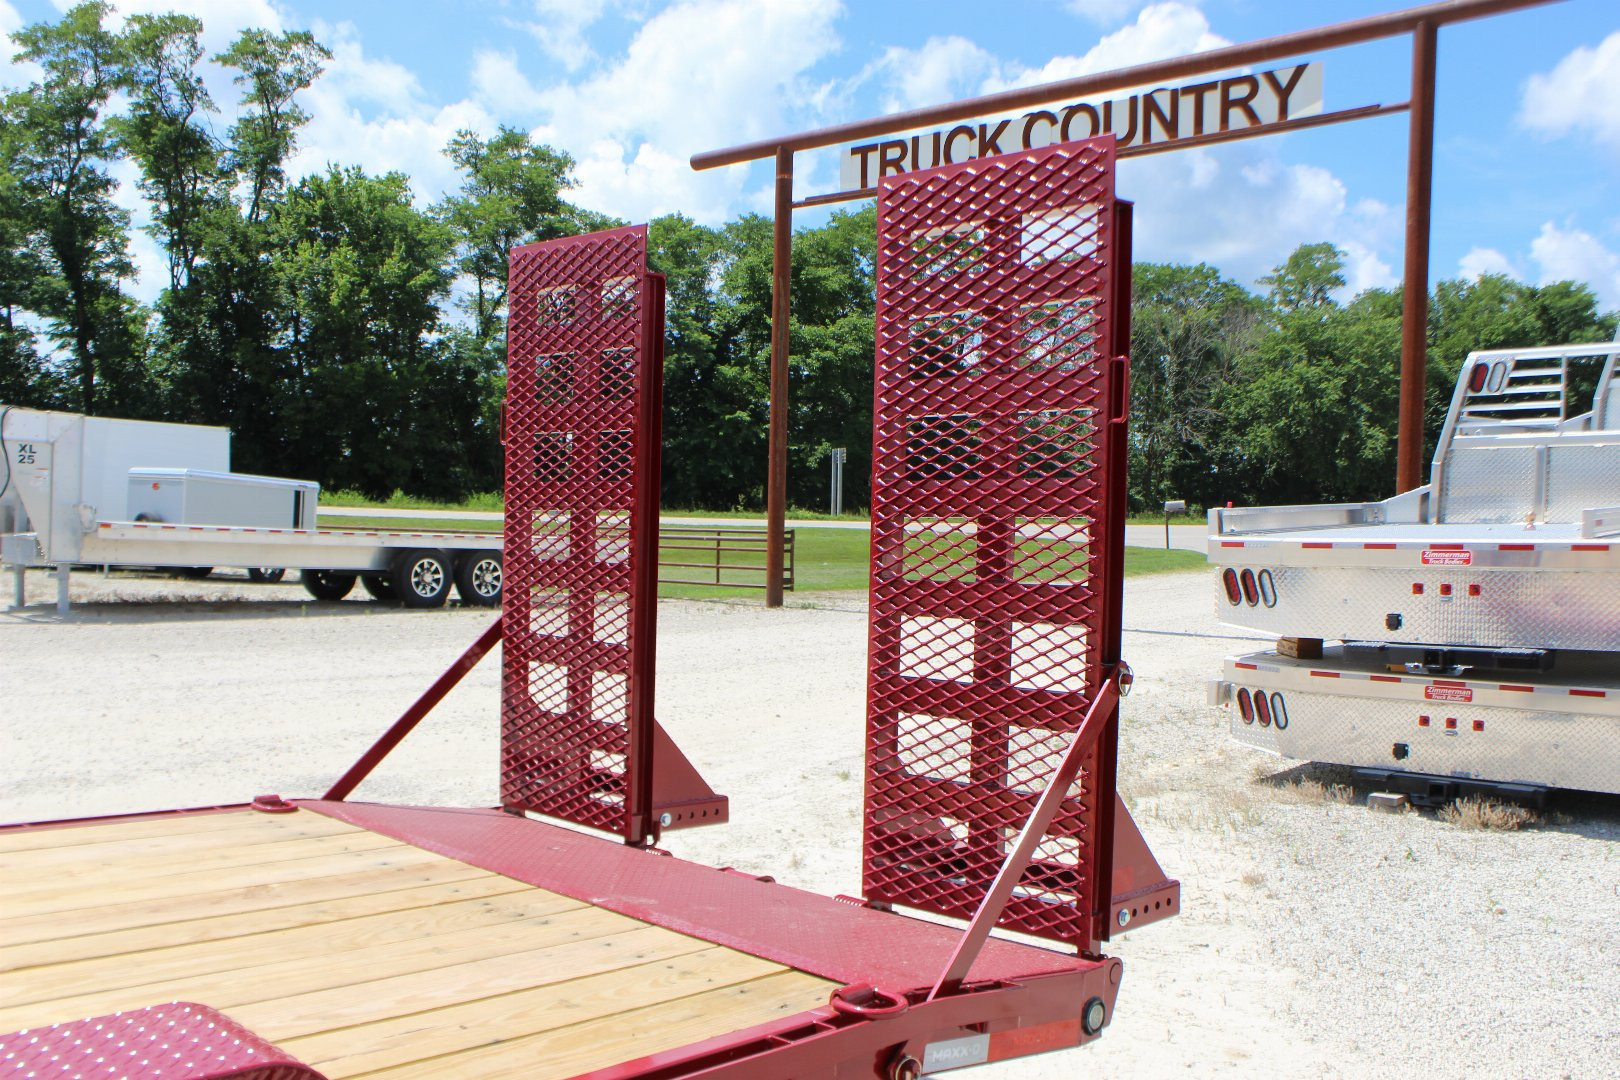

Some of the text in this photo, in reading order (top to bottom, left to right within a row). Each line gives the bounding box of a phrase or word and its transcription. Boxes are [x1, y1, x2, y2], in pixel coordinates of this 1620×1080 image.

[851, 63, 1309, 188] TRUCK COUNTRY
[17, 443, 37, 454] XL
[17, 454, 35, 465] 25
[1426, 686, 1471, 695] Zimmerman
